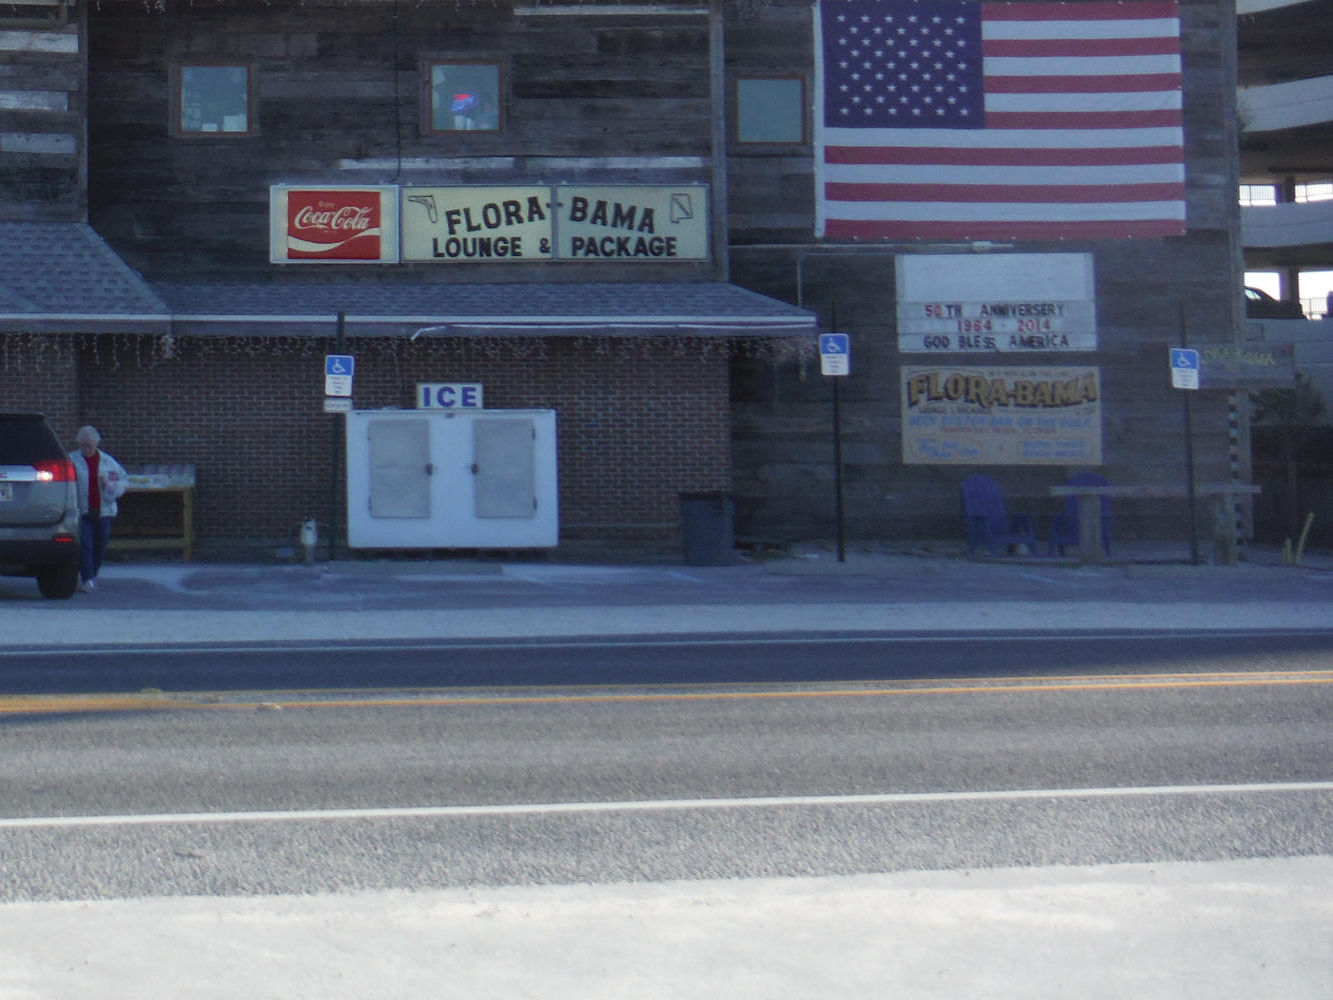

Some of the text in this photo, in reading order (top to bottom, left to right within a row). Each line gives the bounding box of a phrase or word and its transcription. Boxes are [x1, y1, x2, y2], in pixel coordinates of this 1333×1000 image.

[294, 206, 373, 230] Coca-Cola
[433, 236, 677, 258] LOUNGE & PACKAGE
[957, 319, 992, 332] 1964
[1017, 319, 1051, 332] 2014
[923, 336, 950, 348] GOD
[1009, 335, 1069, 347] AMERICA
[423, 386, 477, 407] ICE
[907, 371, 1098, 409] FLORA-BAMA
